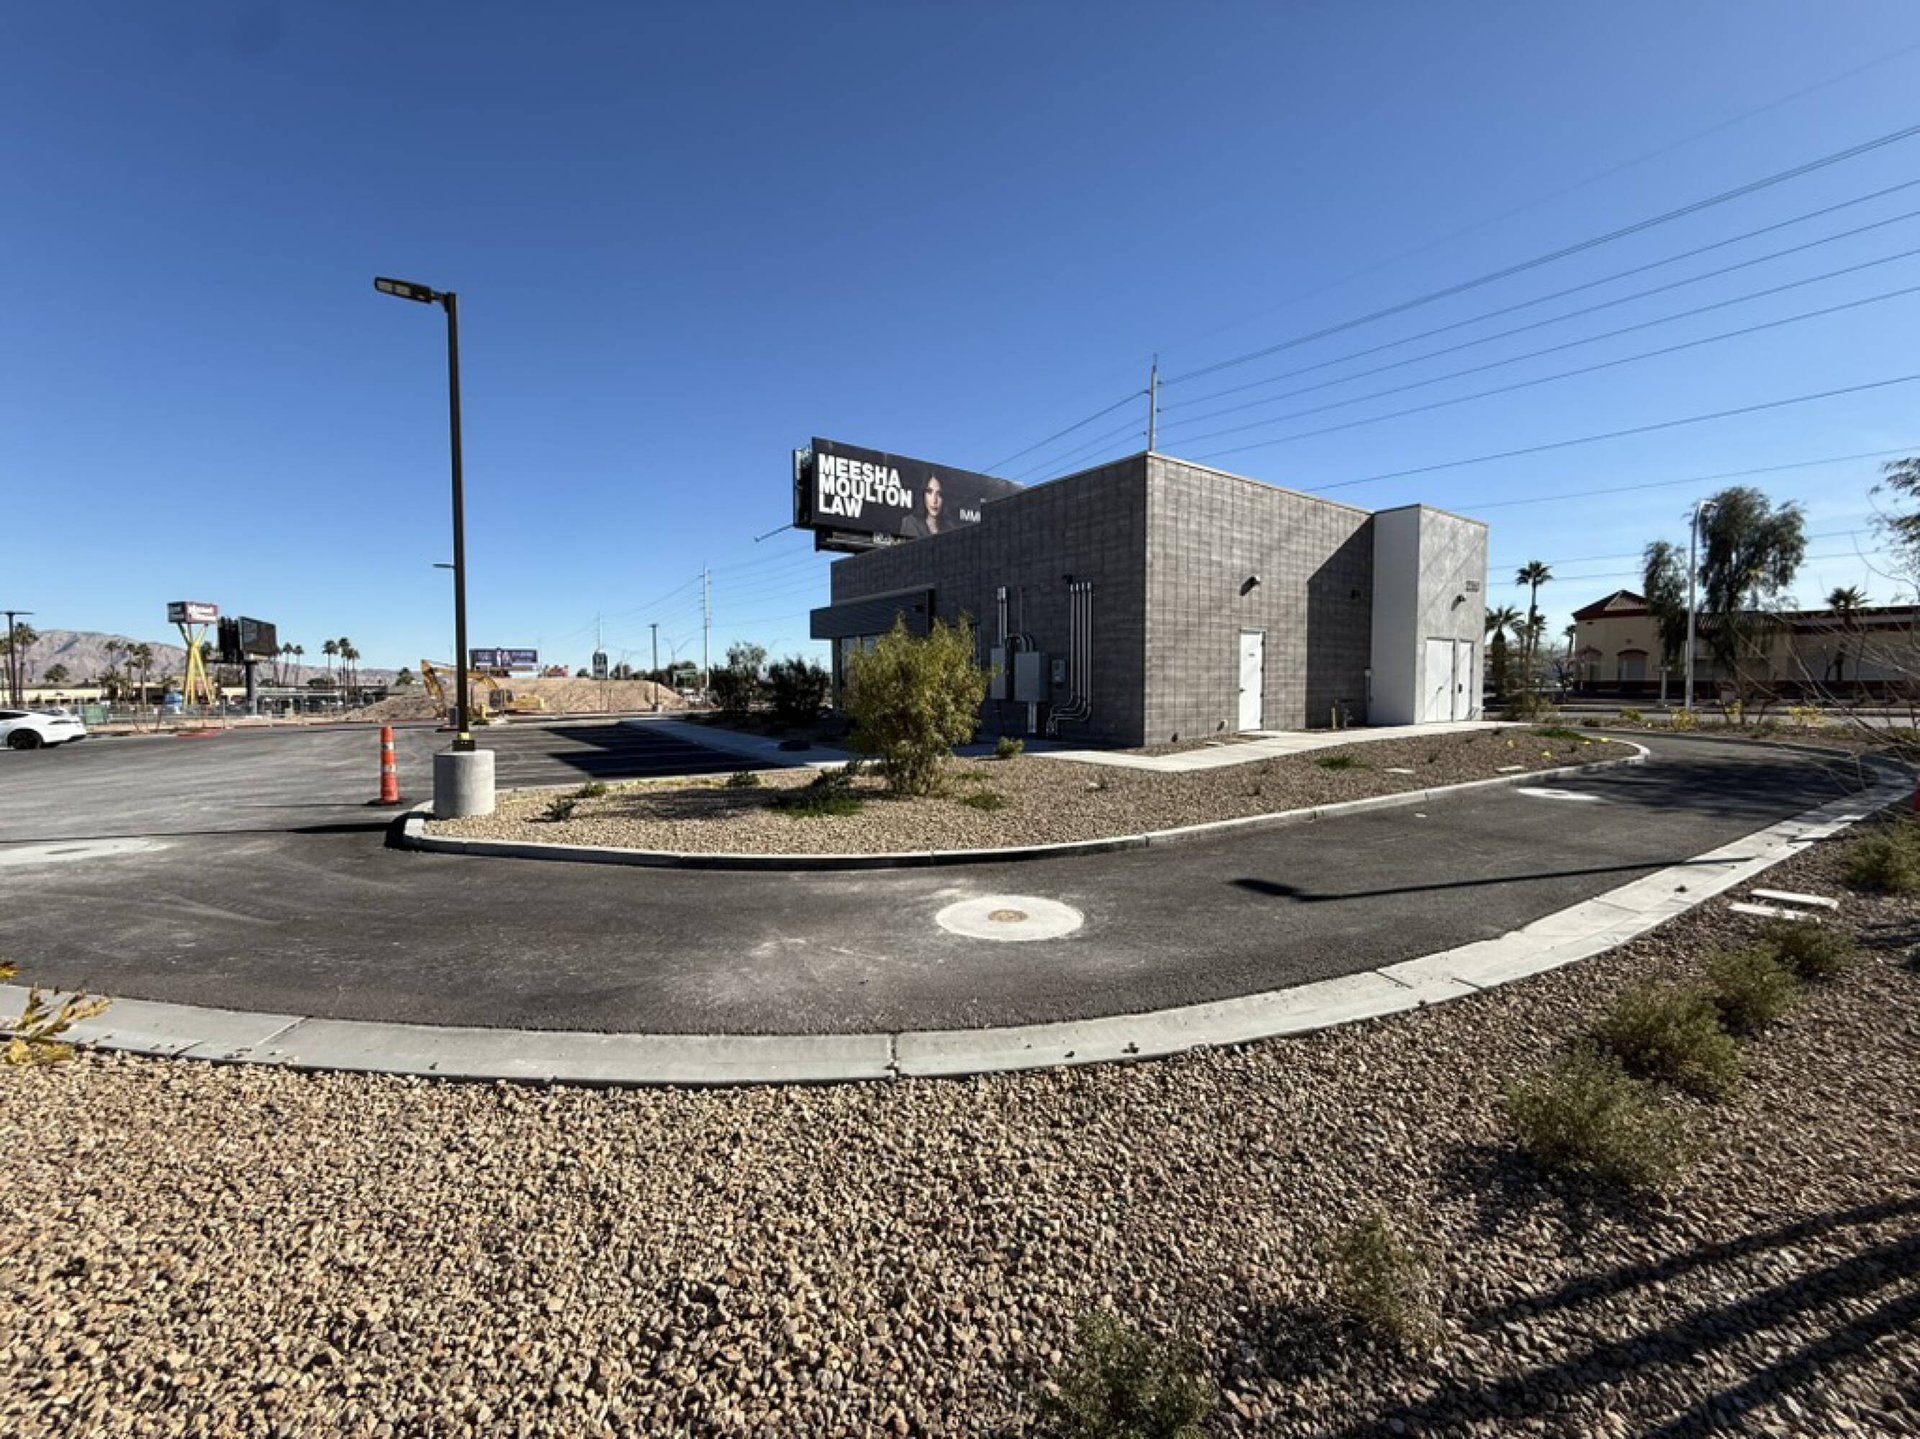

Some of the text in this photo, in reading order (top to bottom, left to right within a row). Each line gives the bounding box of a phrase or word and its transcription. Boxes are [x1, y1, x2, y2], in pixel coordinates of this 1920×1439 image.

[819, 453, 901, 488] MEESHA
[819, 474, 912, 508] MOULTON
[819, 494, 863, 517] LAW
